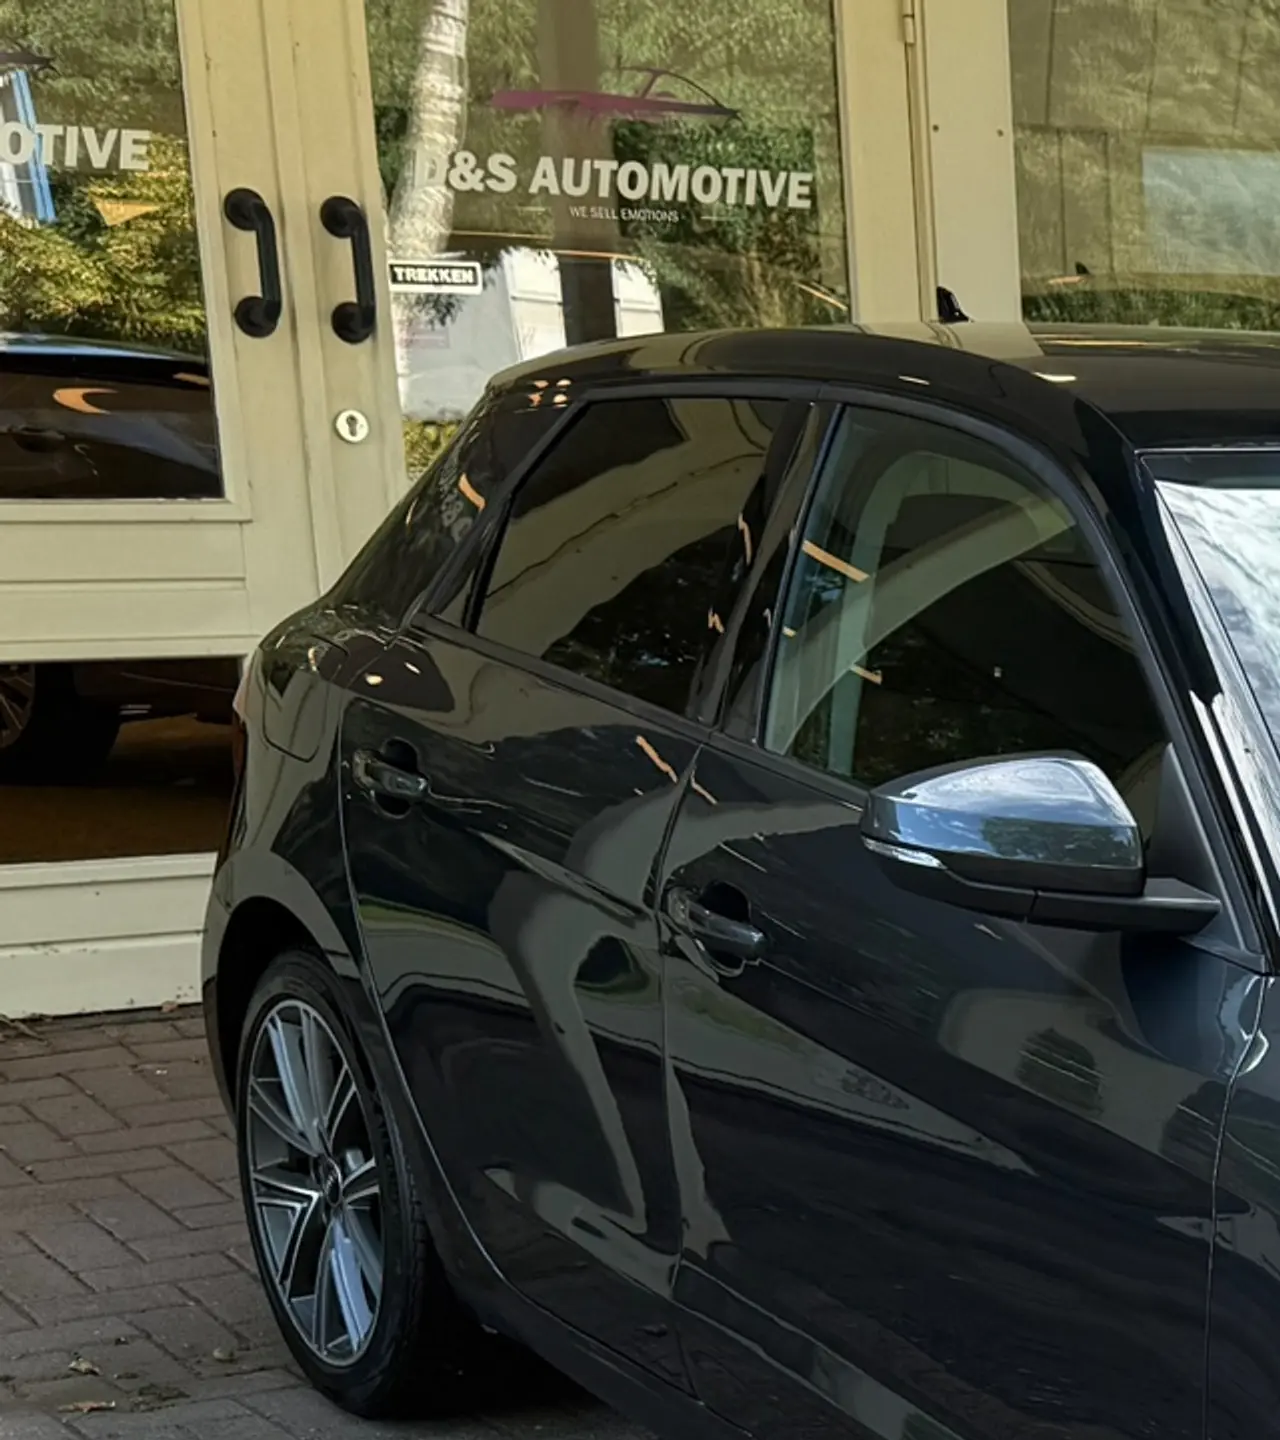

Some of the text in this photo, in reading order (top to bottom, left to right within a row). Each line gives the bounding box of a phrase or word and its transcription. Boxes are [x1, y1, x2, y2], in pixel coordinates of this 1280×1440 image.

[0, 121, 151, 171] OTIVE
[414, 149, 814, 209] D&S AUTOMOTIVE
[569, 205, 680, 223] WE SELL EMOTIONS
[393, 266, 475, 284] TREKKEN
